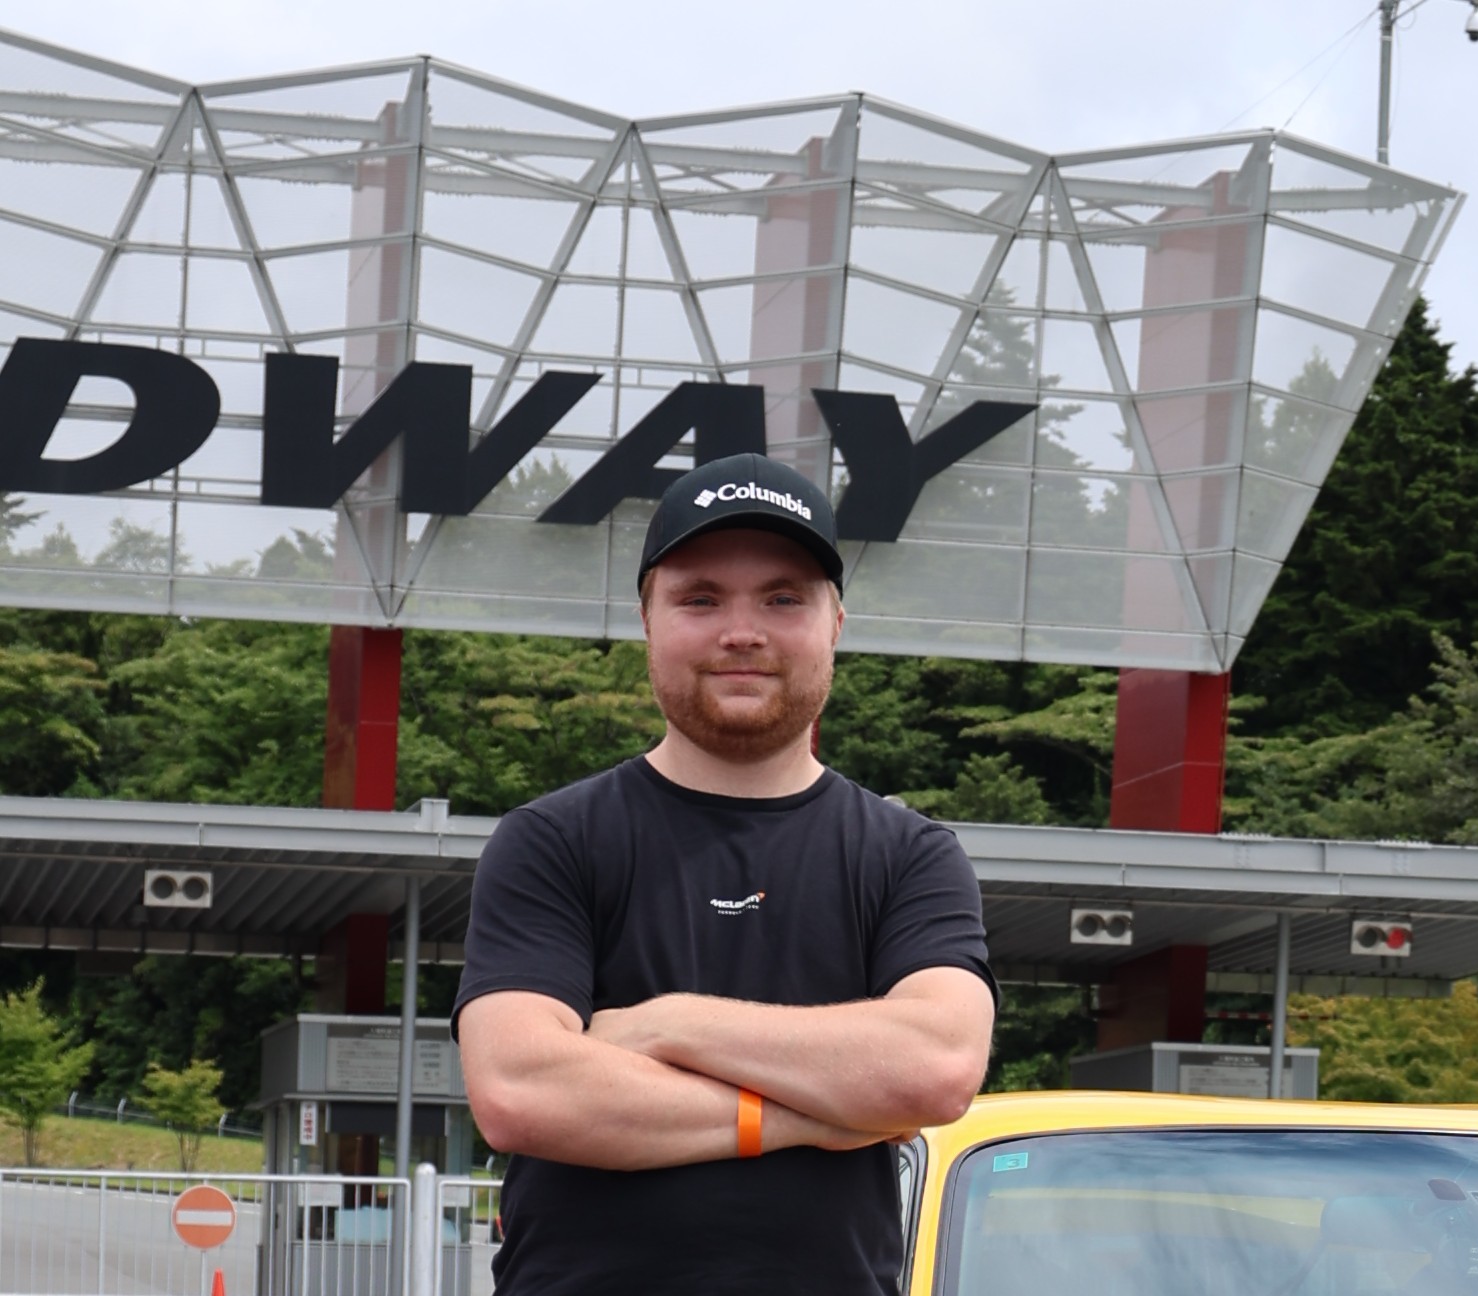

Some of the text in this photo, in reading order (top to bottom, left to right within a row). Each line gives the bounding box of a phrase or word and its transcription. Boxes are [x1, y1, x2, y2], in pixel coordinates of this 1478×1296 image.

[0, 337, 1038, 543] DWAY
[717, 482, 812, 521] Columbia
[1007, 1158, 1020, 1168] 3
